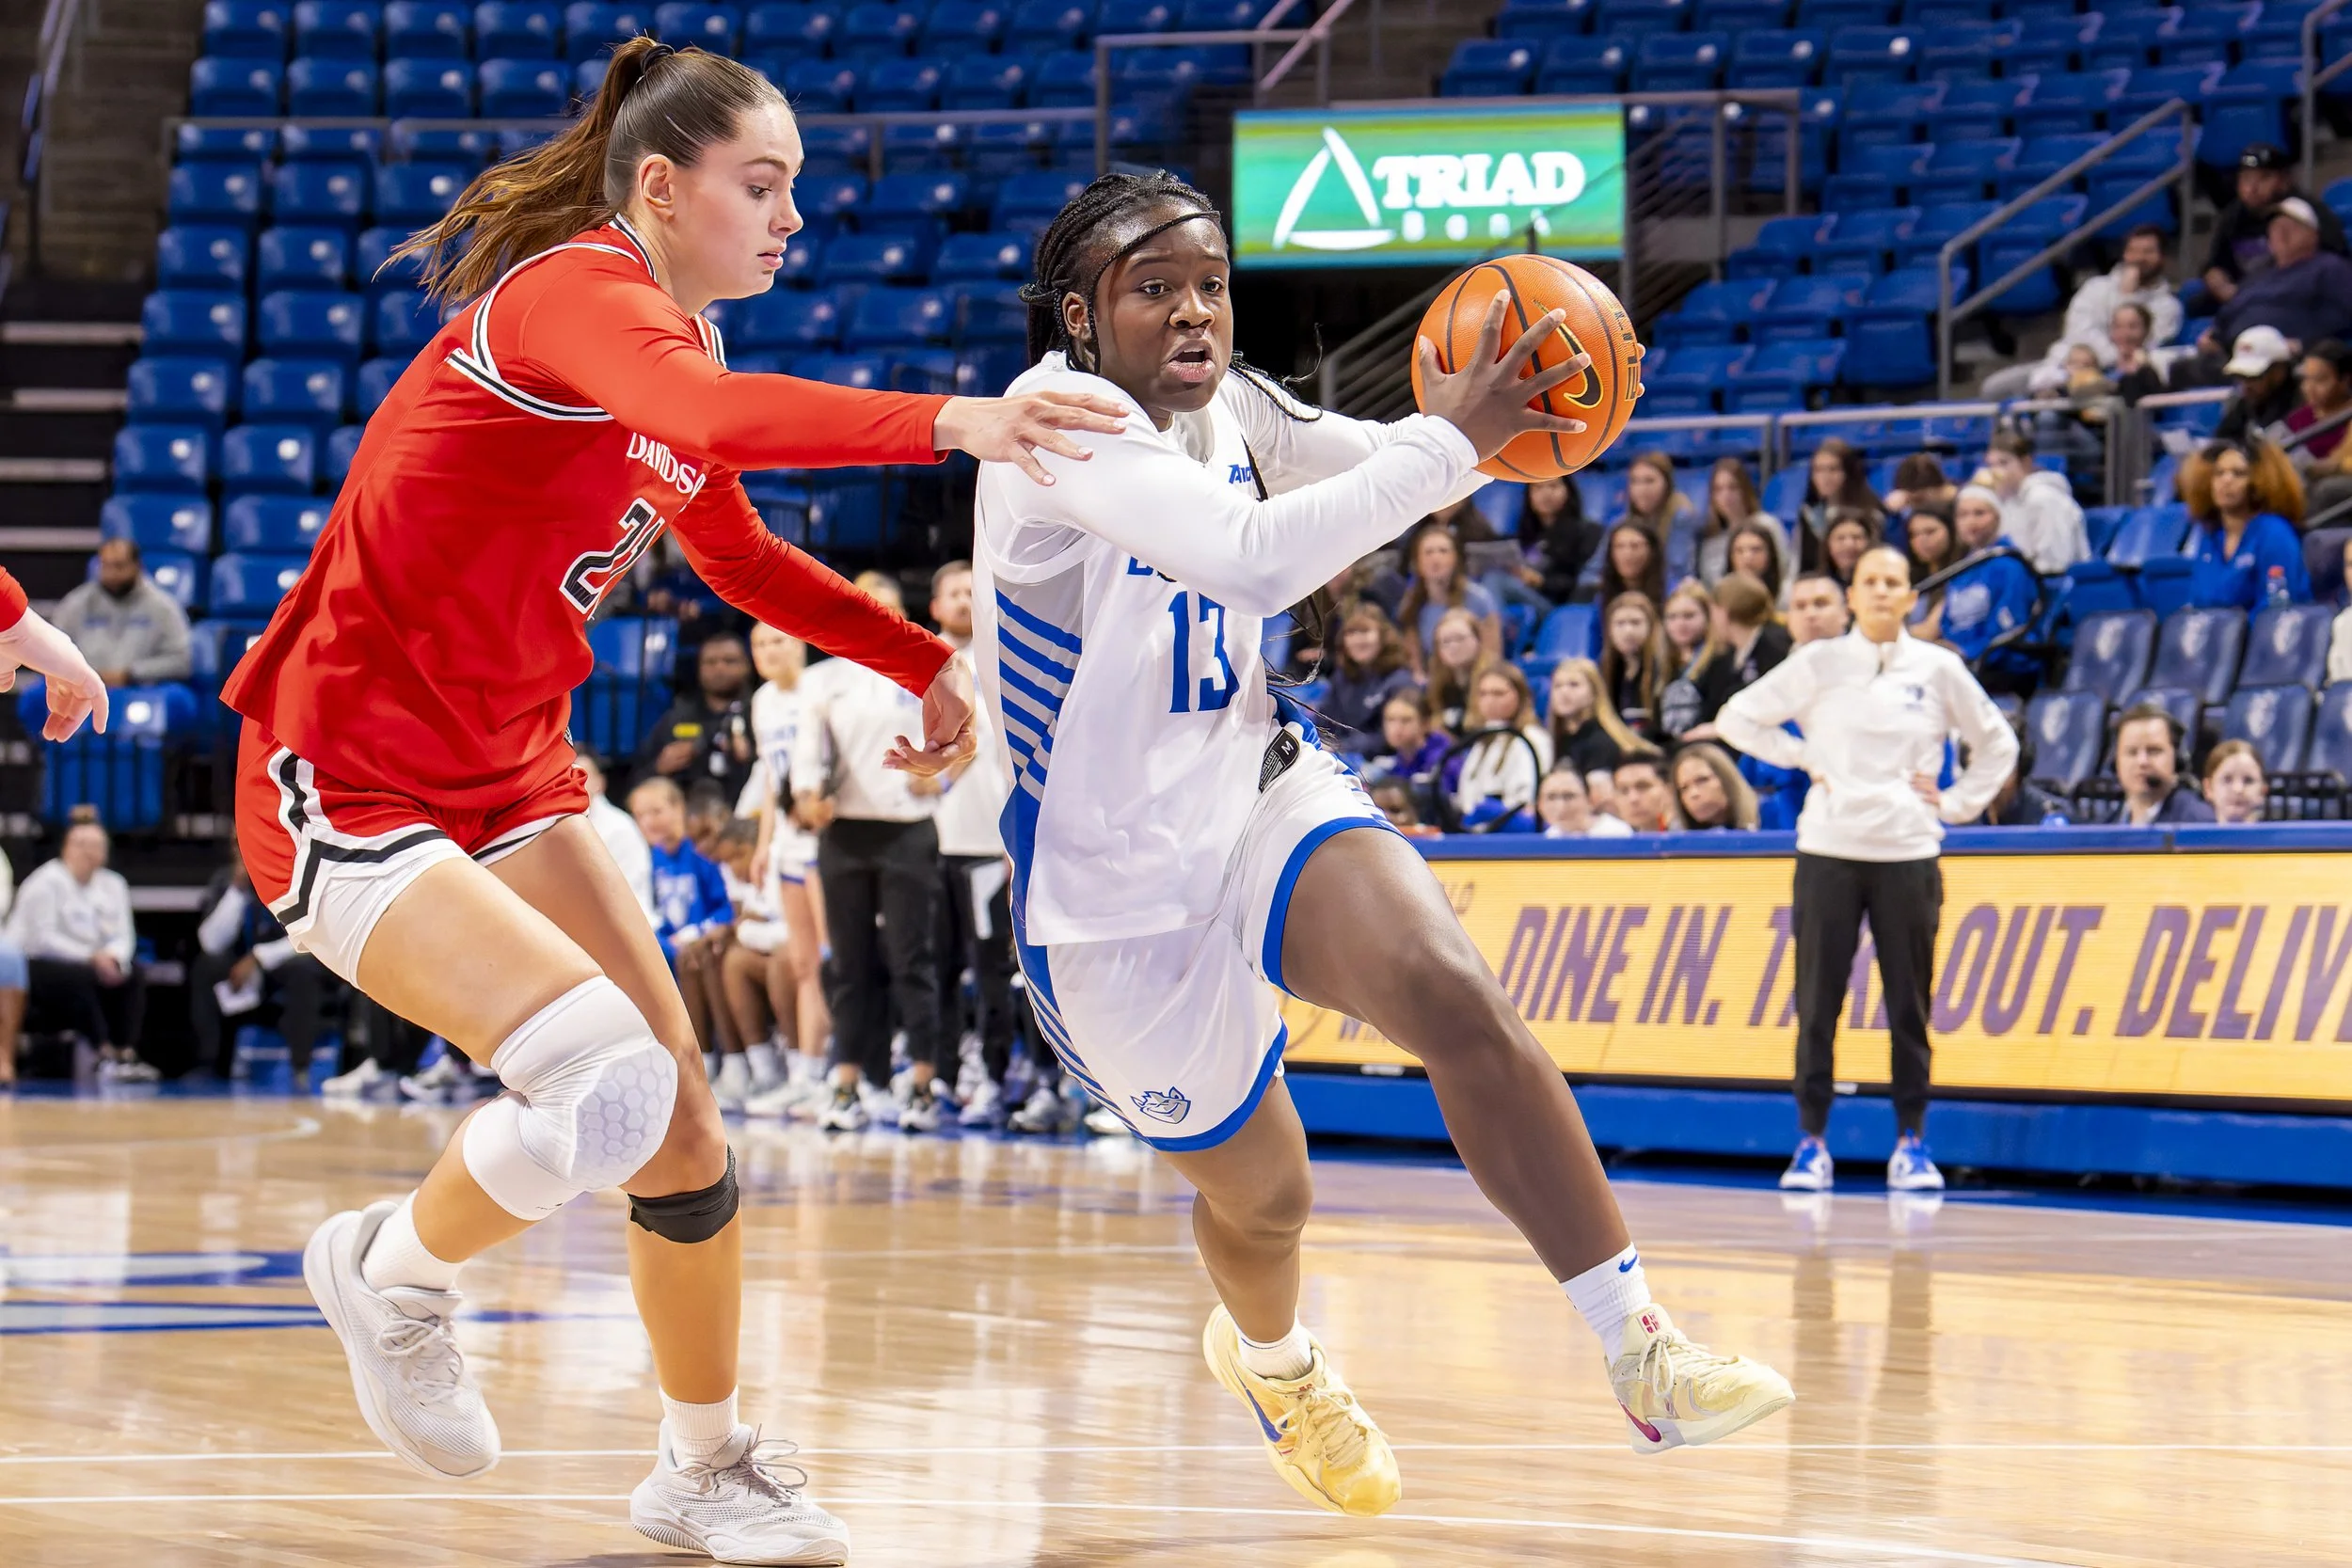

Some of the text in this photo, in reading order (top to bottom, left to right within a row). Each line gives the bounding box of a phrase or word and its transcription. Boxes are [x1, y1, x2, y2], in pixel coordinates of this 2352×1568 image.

[1372, 150, 1586, 210] TRIAD
[1168, 590, 1240, 714] 13
[1280, 740, 1295, 756] M
[1500, 905, 1649, 1023] DINE
[1637, 905, 1733, 1026] IN.
[2114, 904, 2352, 1043] DELIV
